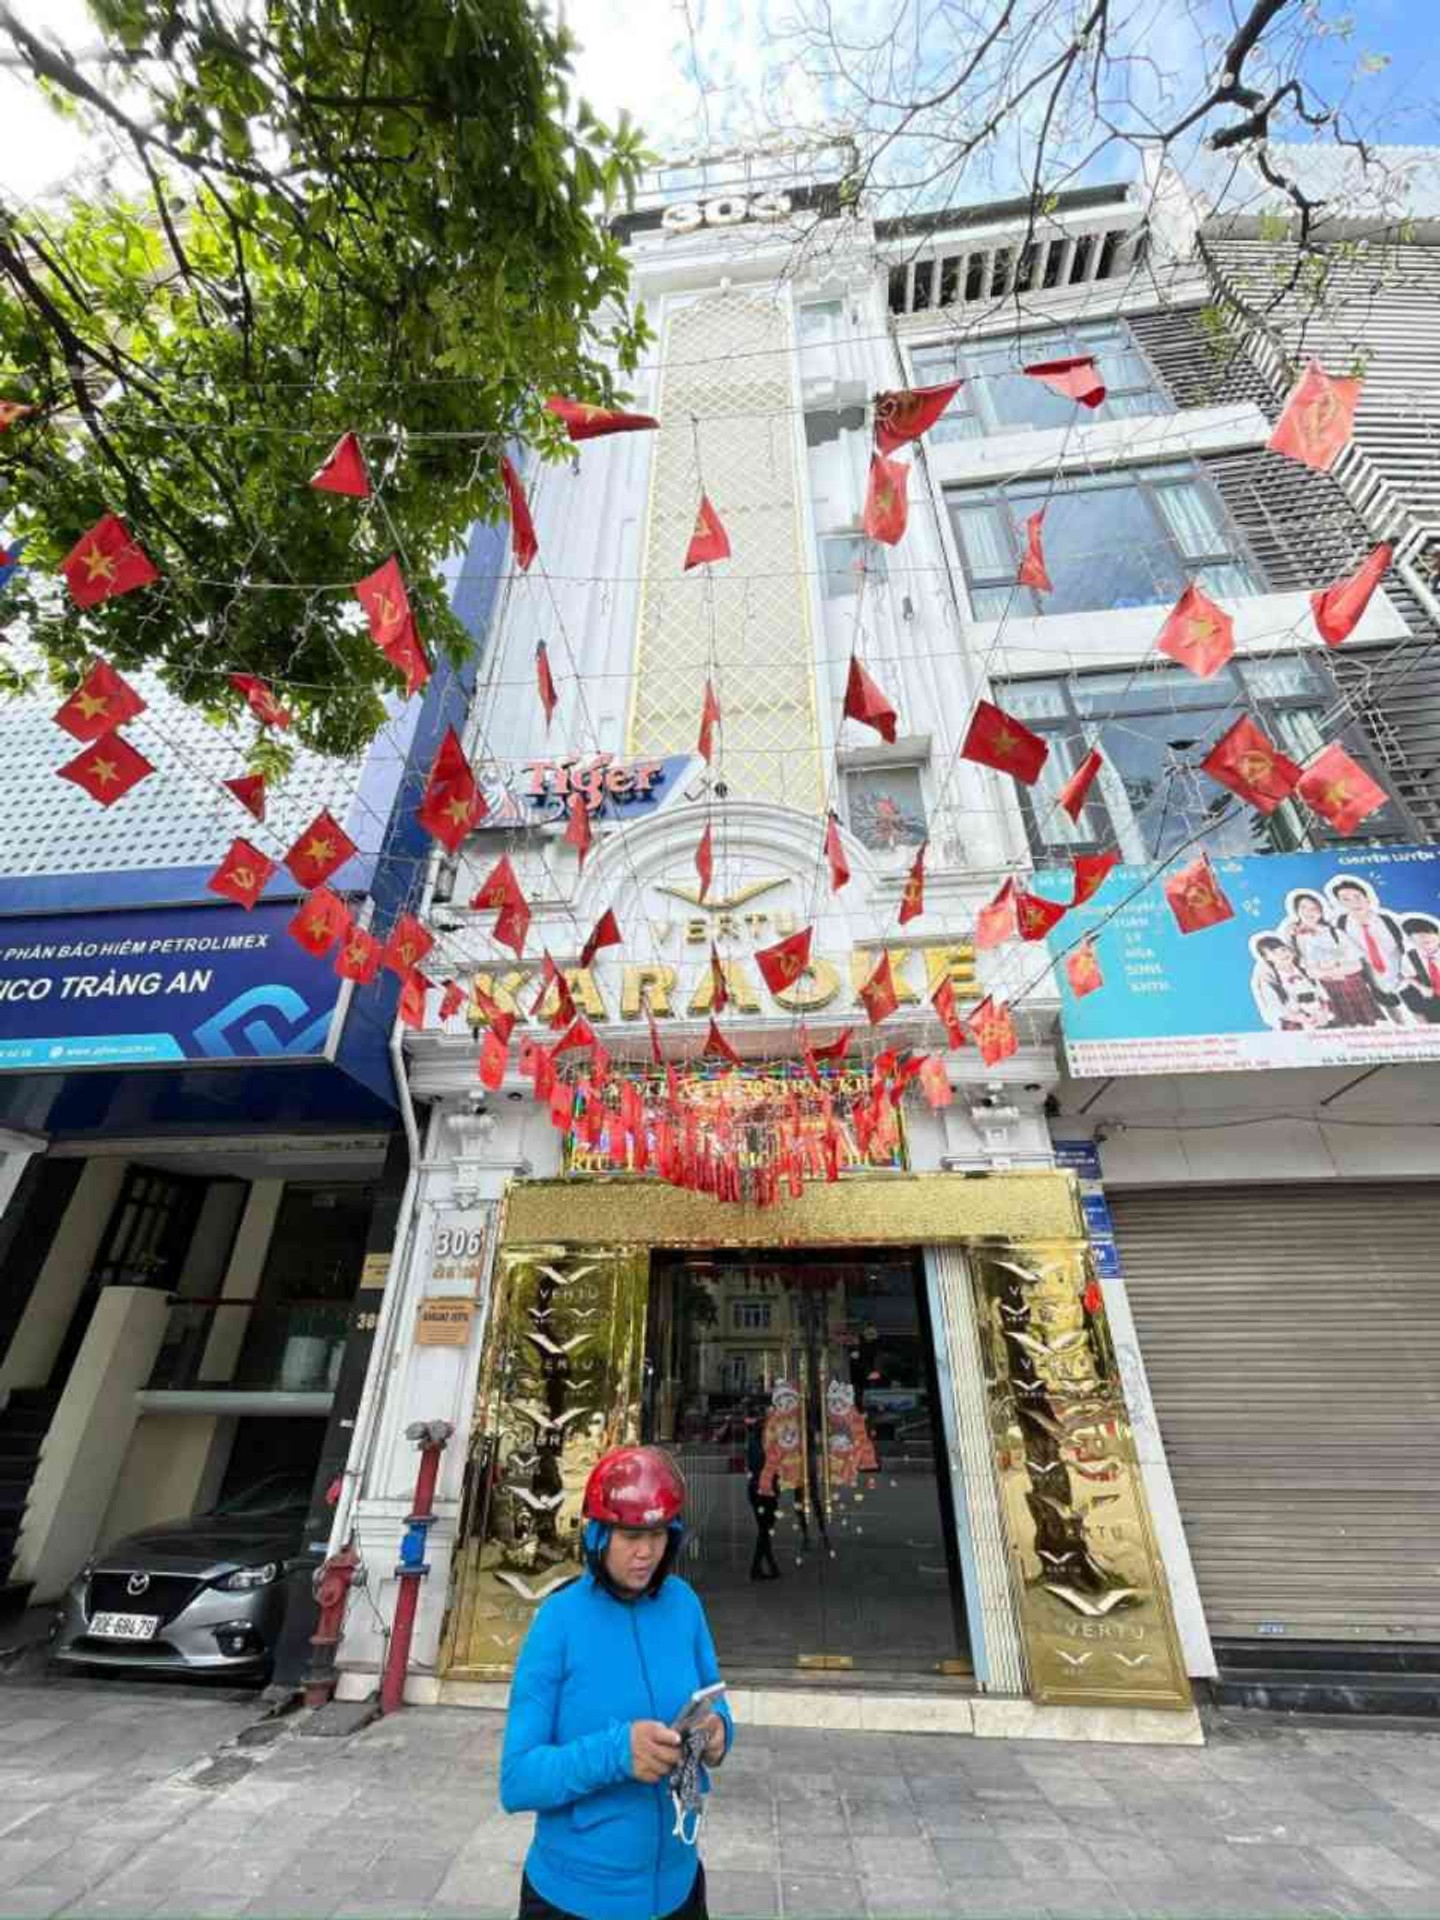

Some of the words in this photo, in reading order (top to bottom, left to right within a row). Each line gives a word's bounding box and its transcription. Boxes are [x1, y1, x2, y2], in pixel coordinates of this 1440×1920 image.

[522, 752, 664, 812] Tiger
[148, 934, 268, 953] PETROLIMEX
[0, 978, 52, 1001] ICO
[164, 969, 213, 994] AN
[467, 944, 982, 1024] KARAOKE
[435, 1230, 482, 1258] 306
[1066, 1621, 1145, 1641] VERTU
